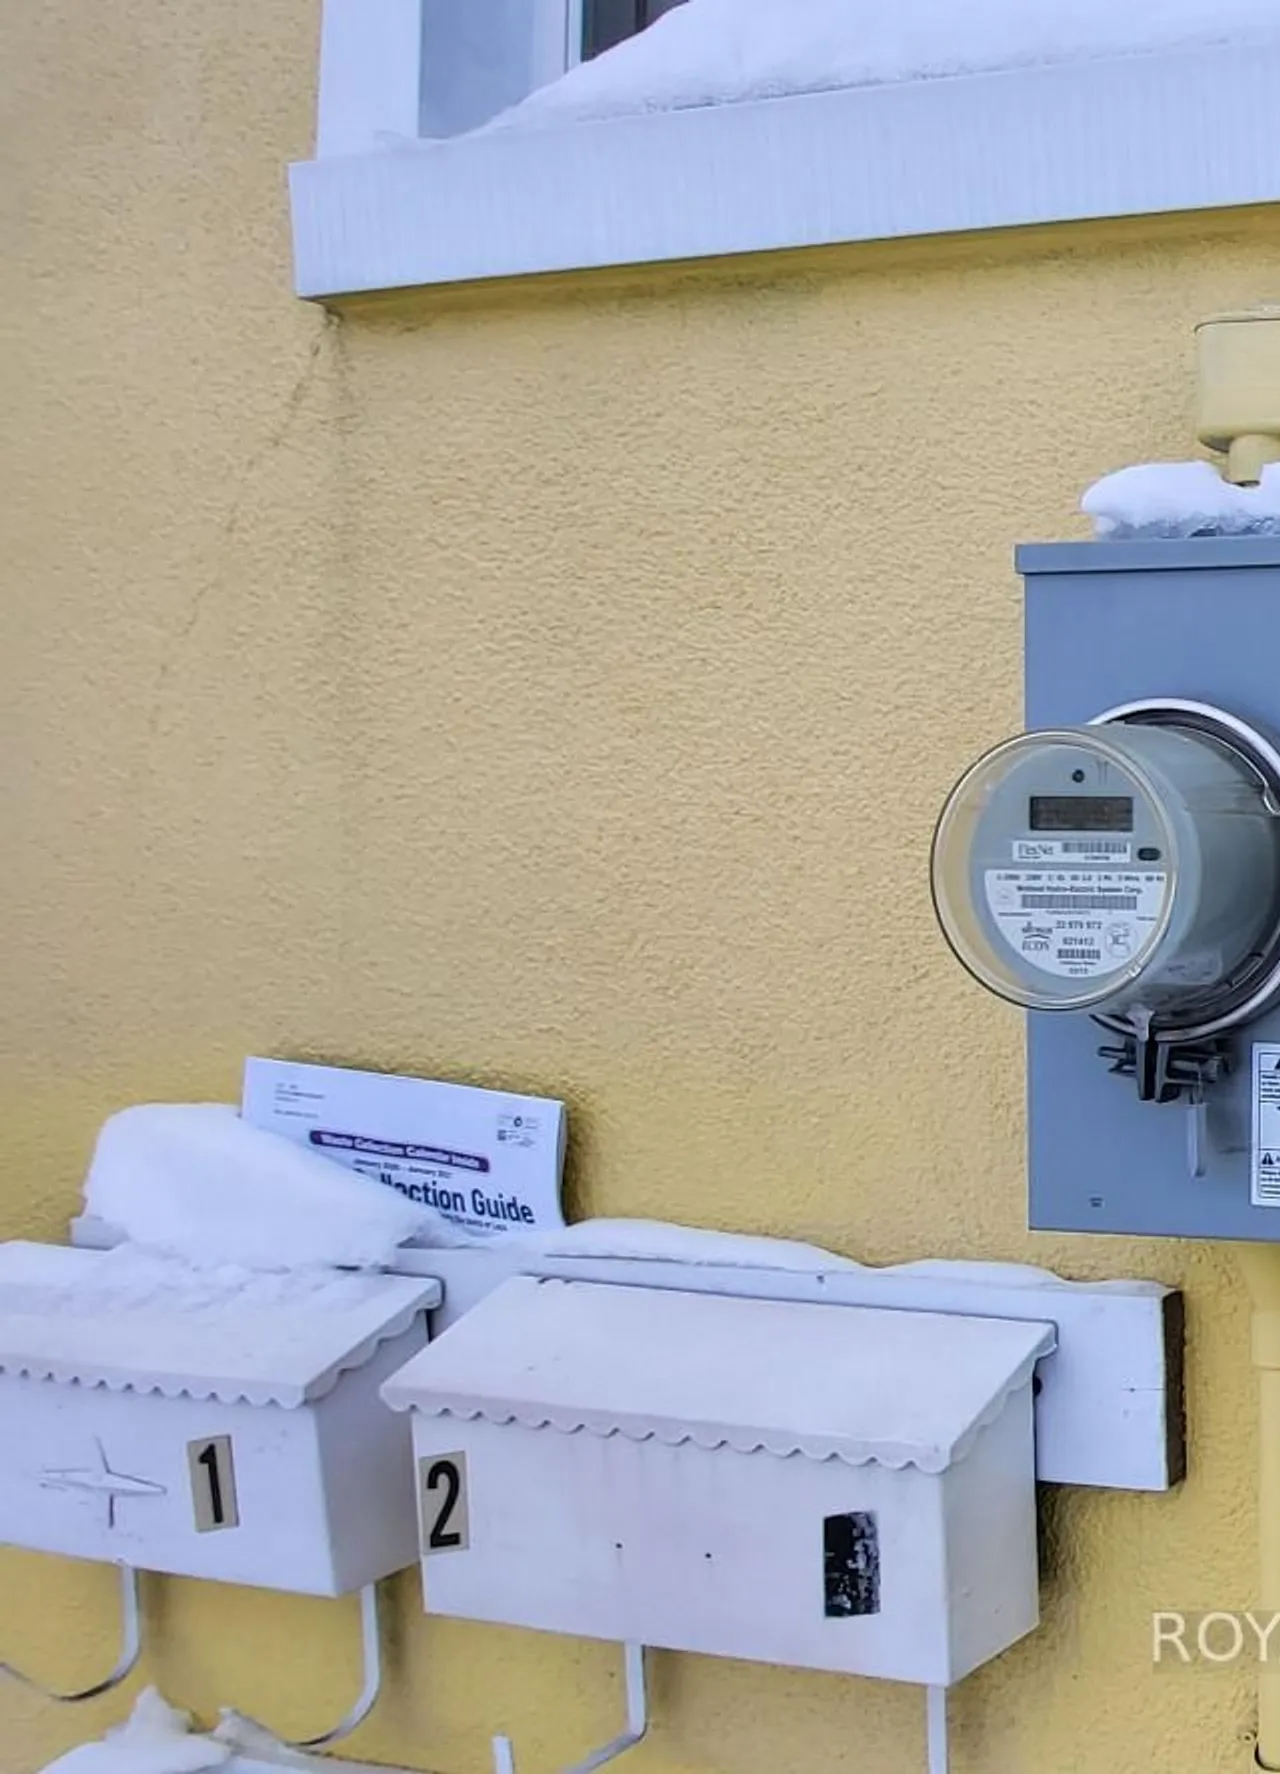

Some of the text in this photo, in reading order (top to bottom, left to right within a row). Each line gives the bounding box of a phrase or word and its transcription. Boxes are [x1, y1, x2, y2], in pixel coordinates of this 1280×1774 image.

[472, 1187, 535, 1224] Guide
[197, 1444, 225, 1524] 1
[427, 1460, 461, 1547] 2
